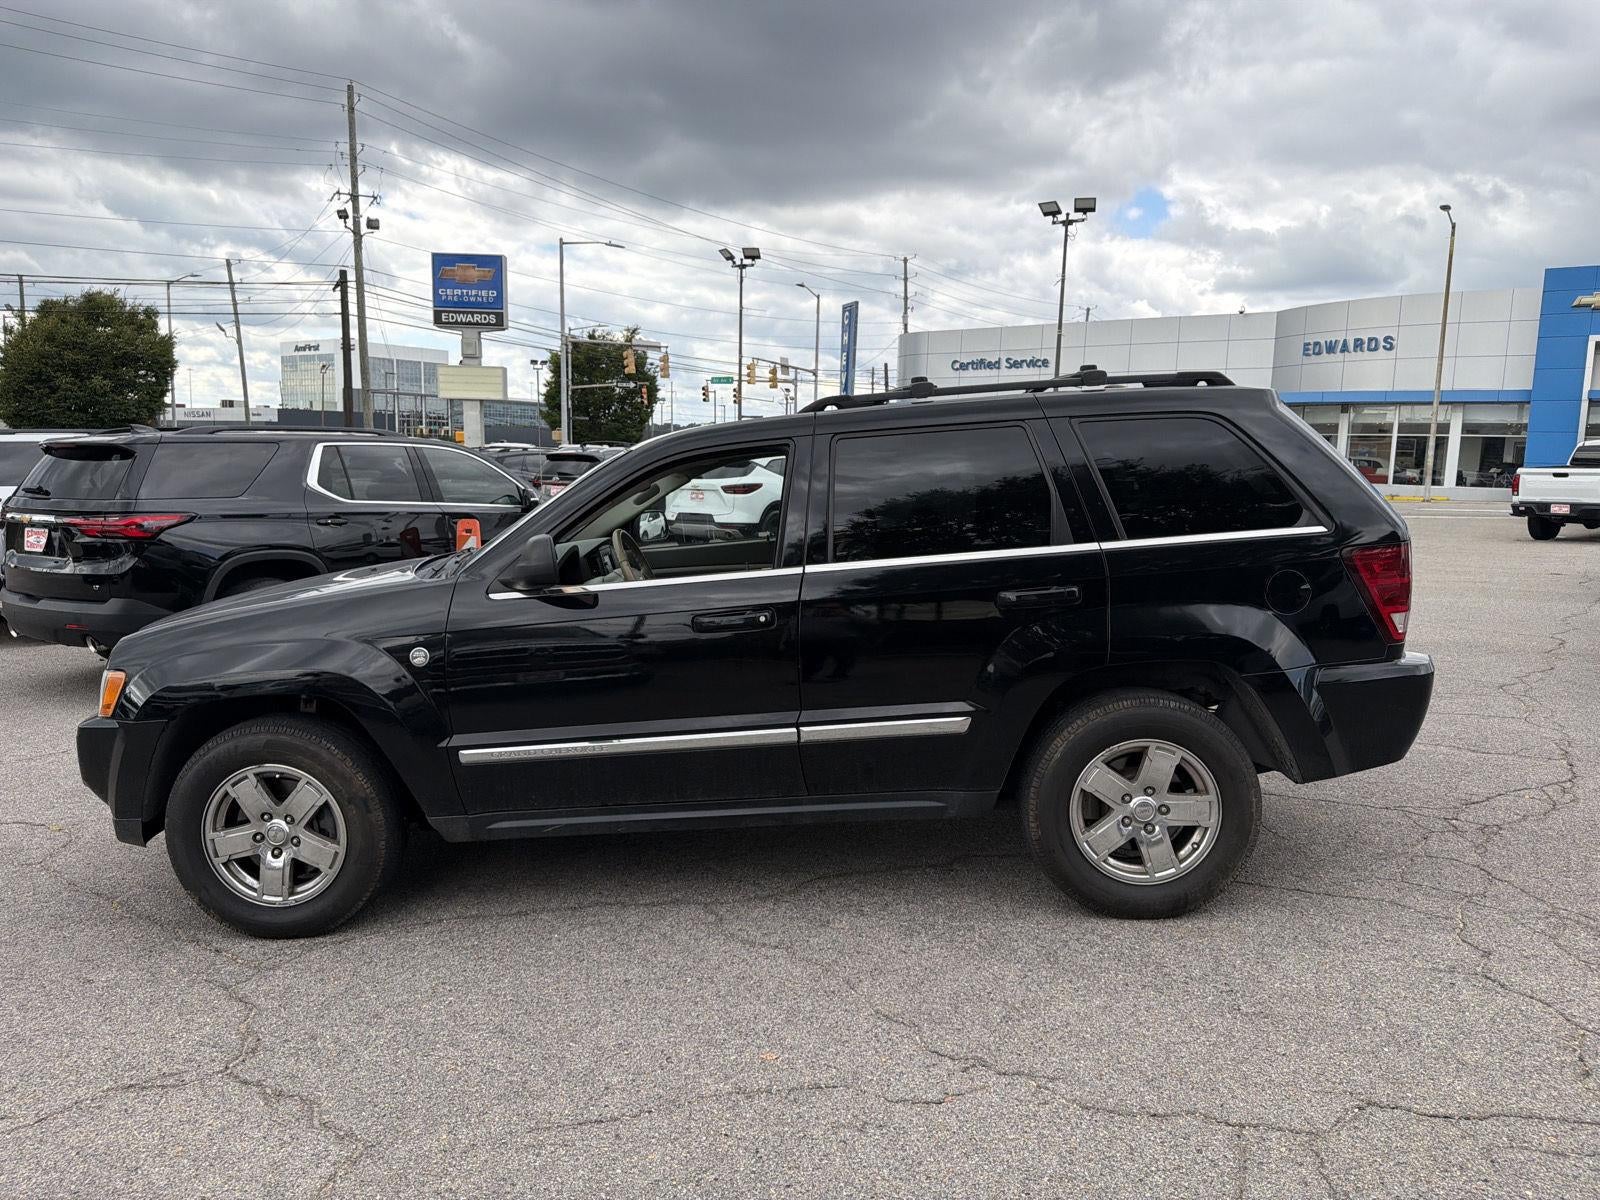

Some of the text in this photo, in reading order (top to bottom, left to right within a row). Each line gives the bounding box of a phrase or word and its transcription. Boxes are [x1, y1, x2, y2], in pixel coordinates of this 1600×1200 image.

[438, 288, 497, 297] CERTIFIED
[441, 295, 494, 303] PRE-OWNED
[441, 313, 497, 324] EDWARDS
[293, 343, 320, 353] AmFirst
[1302, 335, 1396, 357] EDWARDS
[951, 355, 1050, 371] Certified Service
[183, 410, 211, 418] NISSAN
[490, 745, 609, 759] GRAND CHEROKEE
